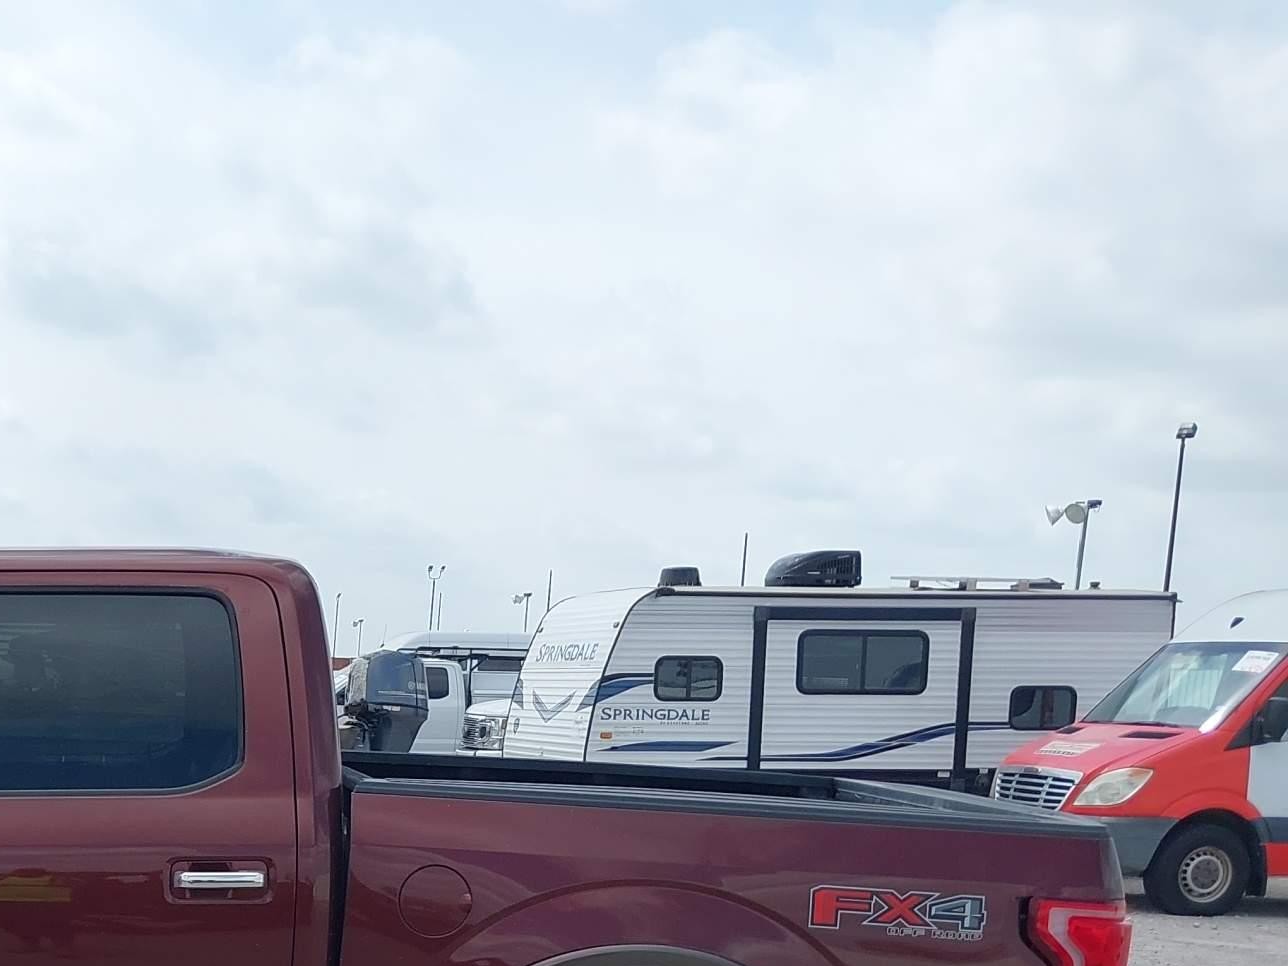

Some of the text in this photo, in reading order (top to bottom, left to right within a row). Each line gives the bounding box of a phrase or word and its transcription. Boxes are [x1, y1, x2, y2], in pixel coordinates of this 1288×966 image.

[536, 643, 599, 663] SPRINGDALE
[600, 707, 711, 721] SPRINGDALE
[808, 884, 987, 932] FX4
